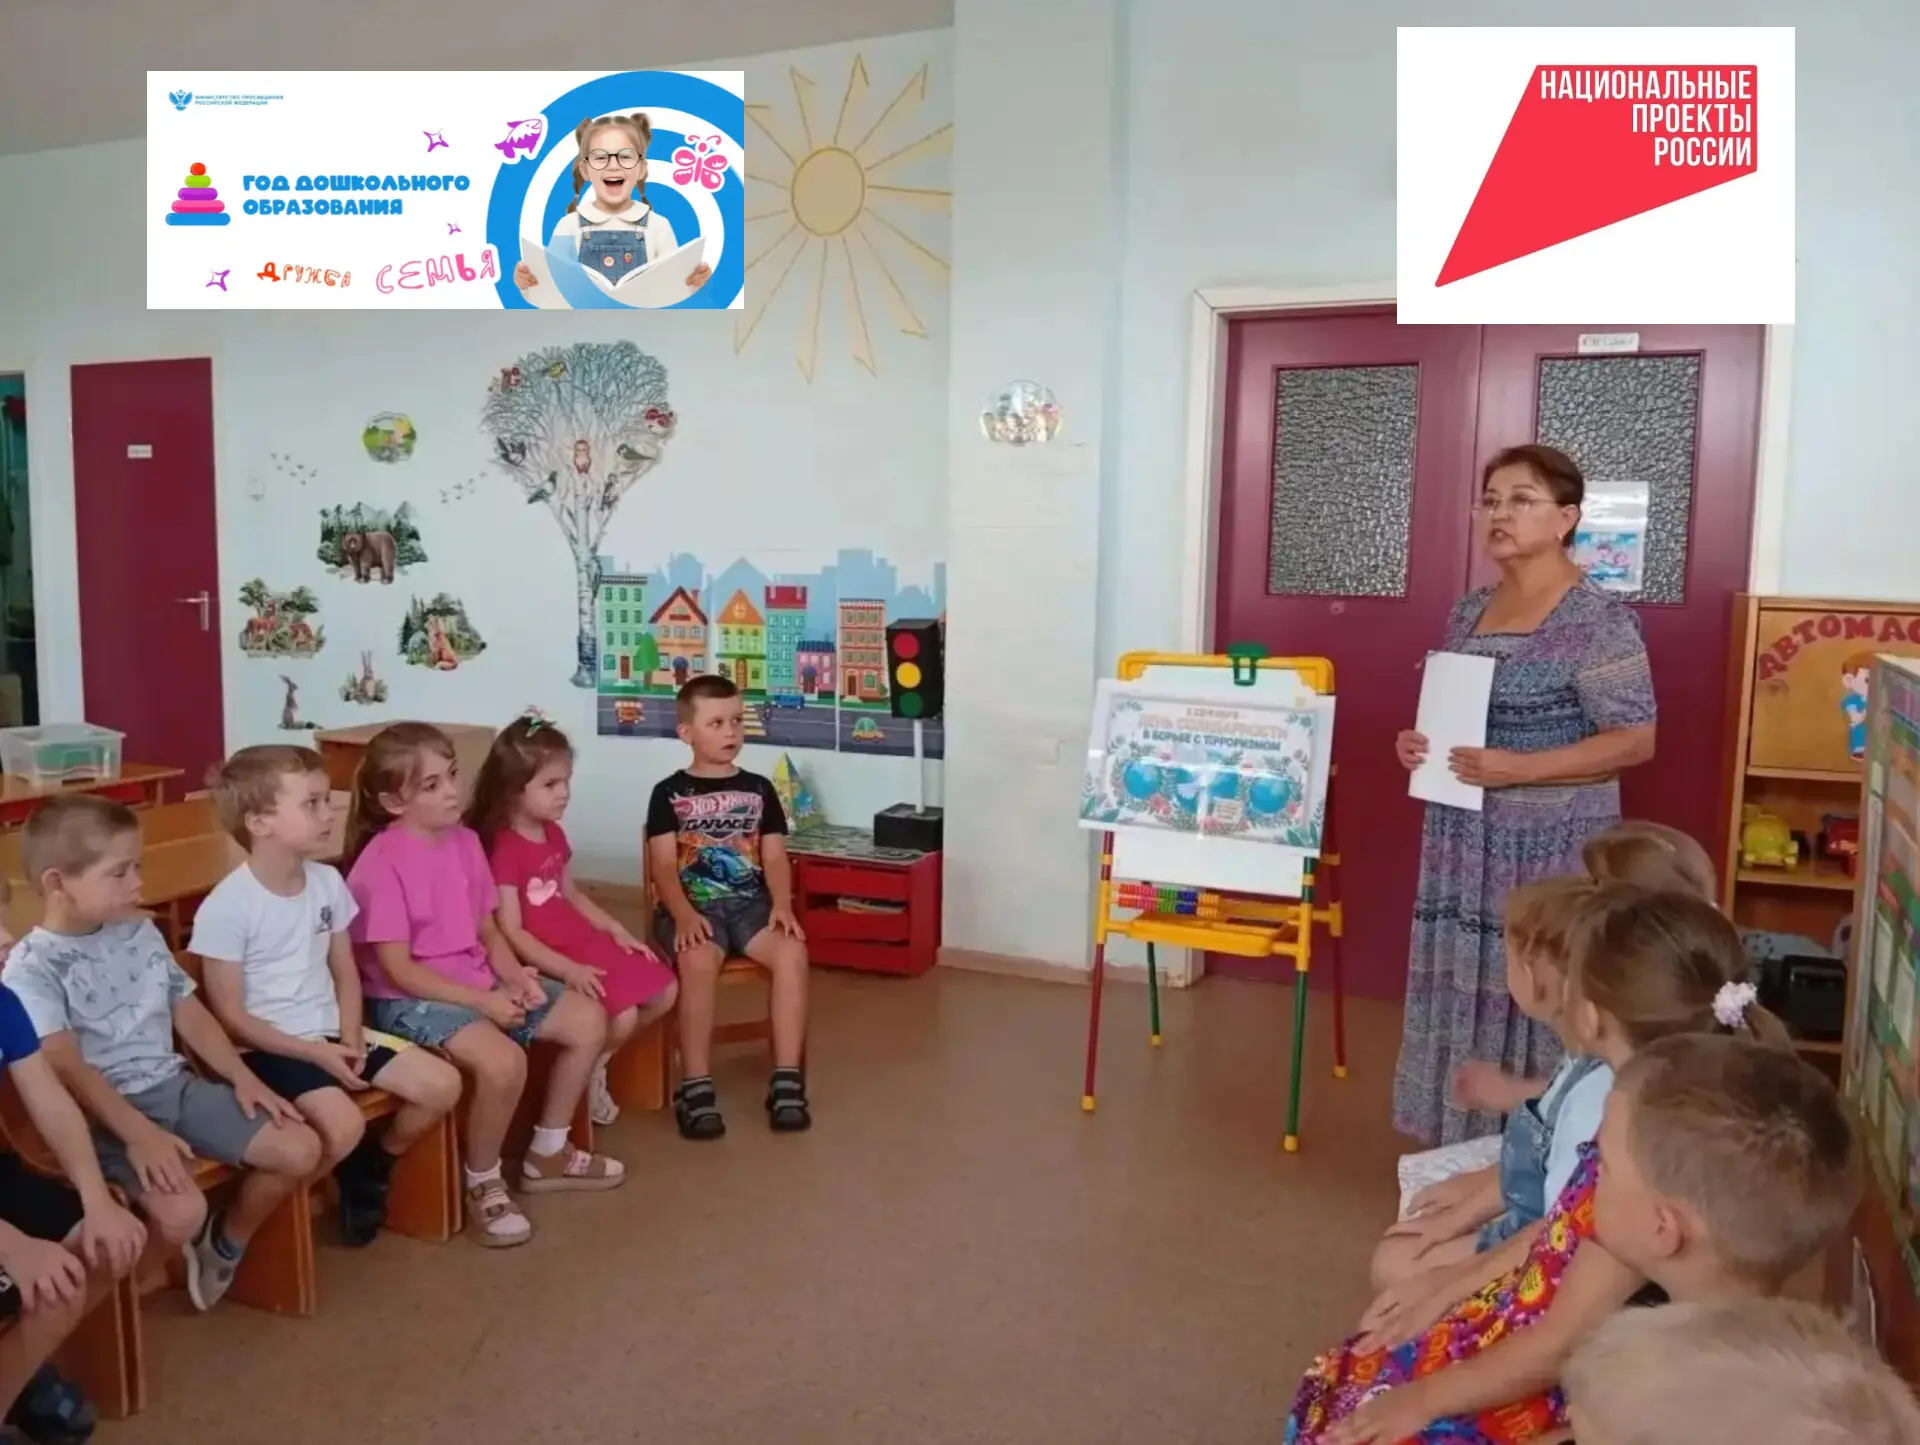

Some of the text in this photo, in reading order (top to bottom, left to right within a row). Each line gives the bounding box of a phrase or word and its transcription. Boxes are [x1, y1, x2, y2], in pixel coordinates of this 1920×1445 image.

[1143, 729, 1281, 751] В БОРЬБЕ С ТЕРРОРИЗМОМ
[686, 818, 755, 830] GARAGE
